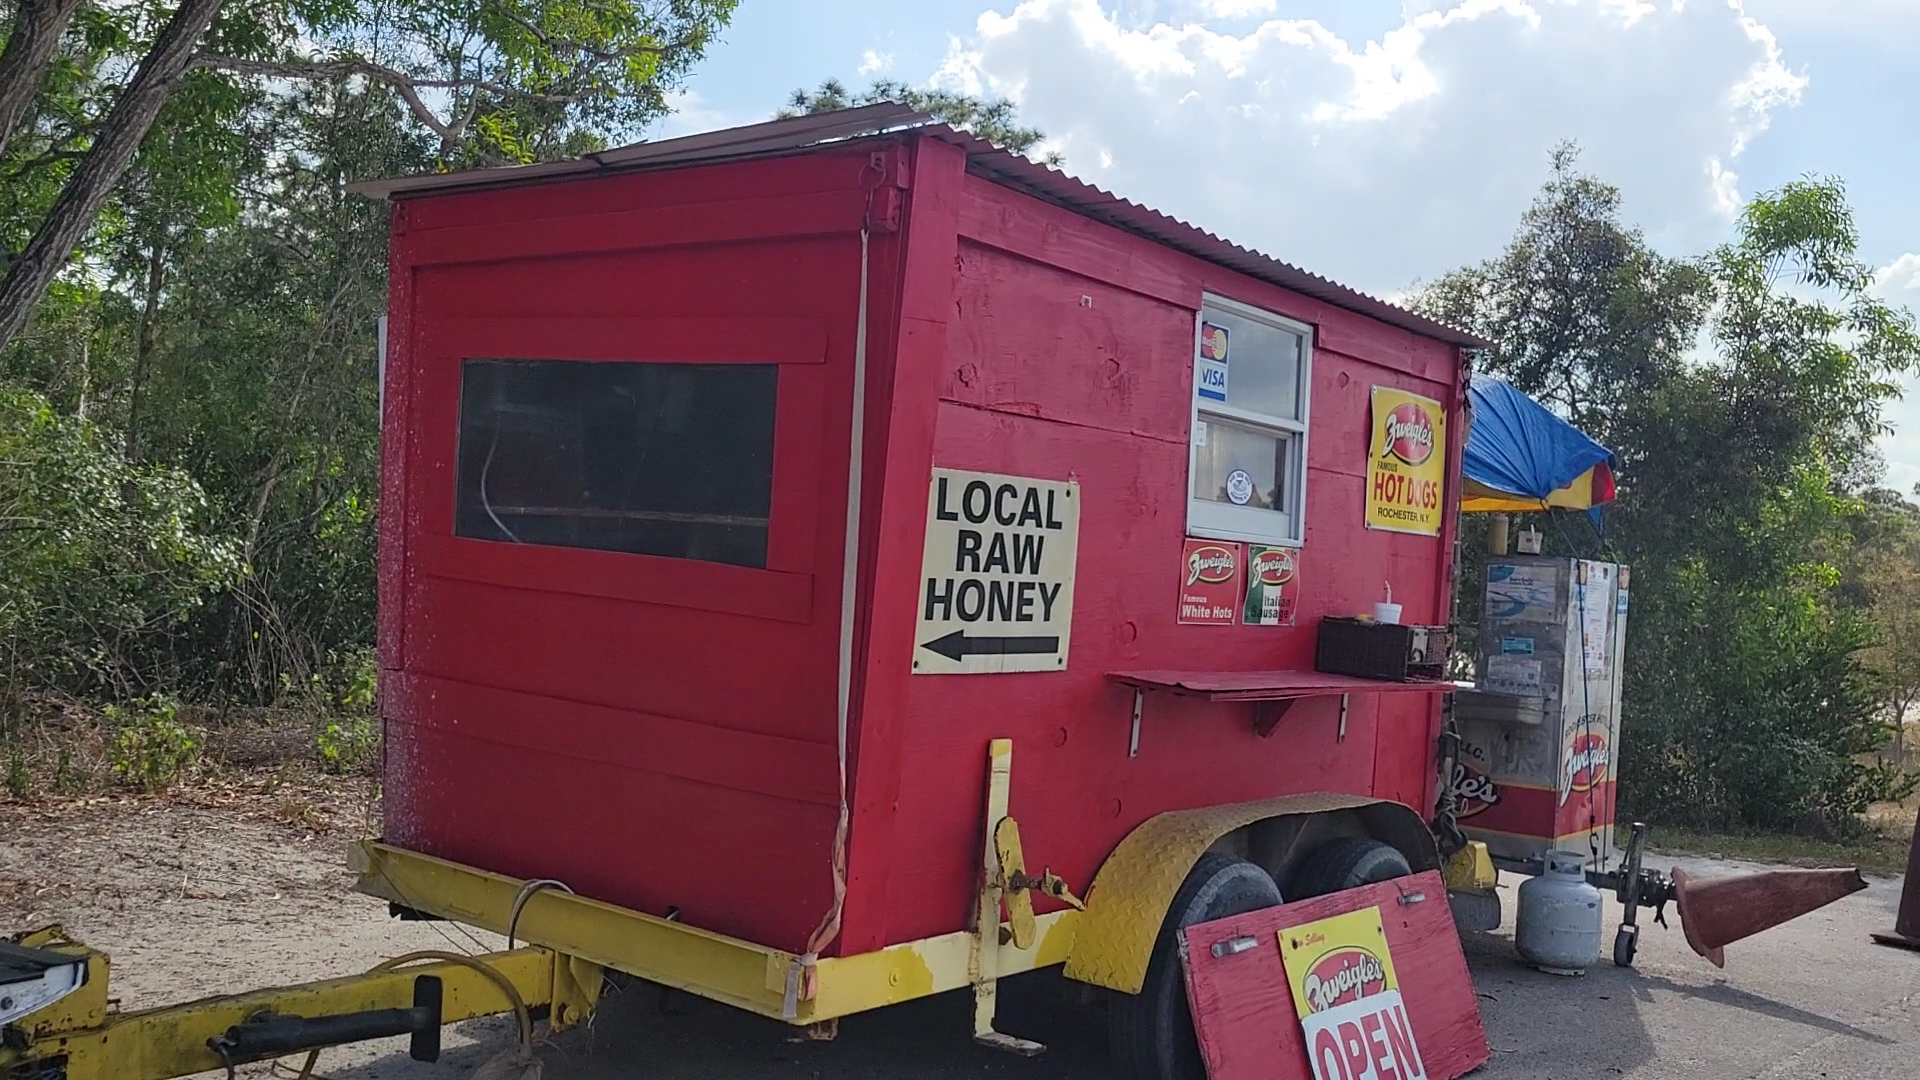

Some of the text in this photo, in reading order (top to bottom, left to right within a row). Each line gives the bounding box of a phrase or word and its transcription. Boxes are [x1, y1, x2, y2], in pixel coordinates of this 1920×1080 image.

[1202, 368, 1225, 389] VISA
[1381, 413, 1433, 459] Zweigle's
[1377, 461, 1398, 473] FAMOUS
[1373, 471, 1437, 510] HOT DOGS
[936, 477, 1063, 530] LOCAL
[1377, 507, 1431, 524] ROCHESTER, N.Y.
[955, 529, 1045, 575] RAW
[924, 577, 1063, 622] HONEY
[1183, 593, 1208, 604] Famous
[1264, 595, 1291, 608] Italian
[1182, 604, 1233, 620] White Hots
[1250, 605, 1290, 621] Sausage
[1305, 932, 1325, 947] Selling
[1305, 953, 1384, 1013] Zweigle's
[1315, 1005, 1421, 1080] OPEN
